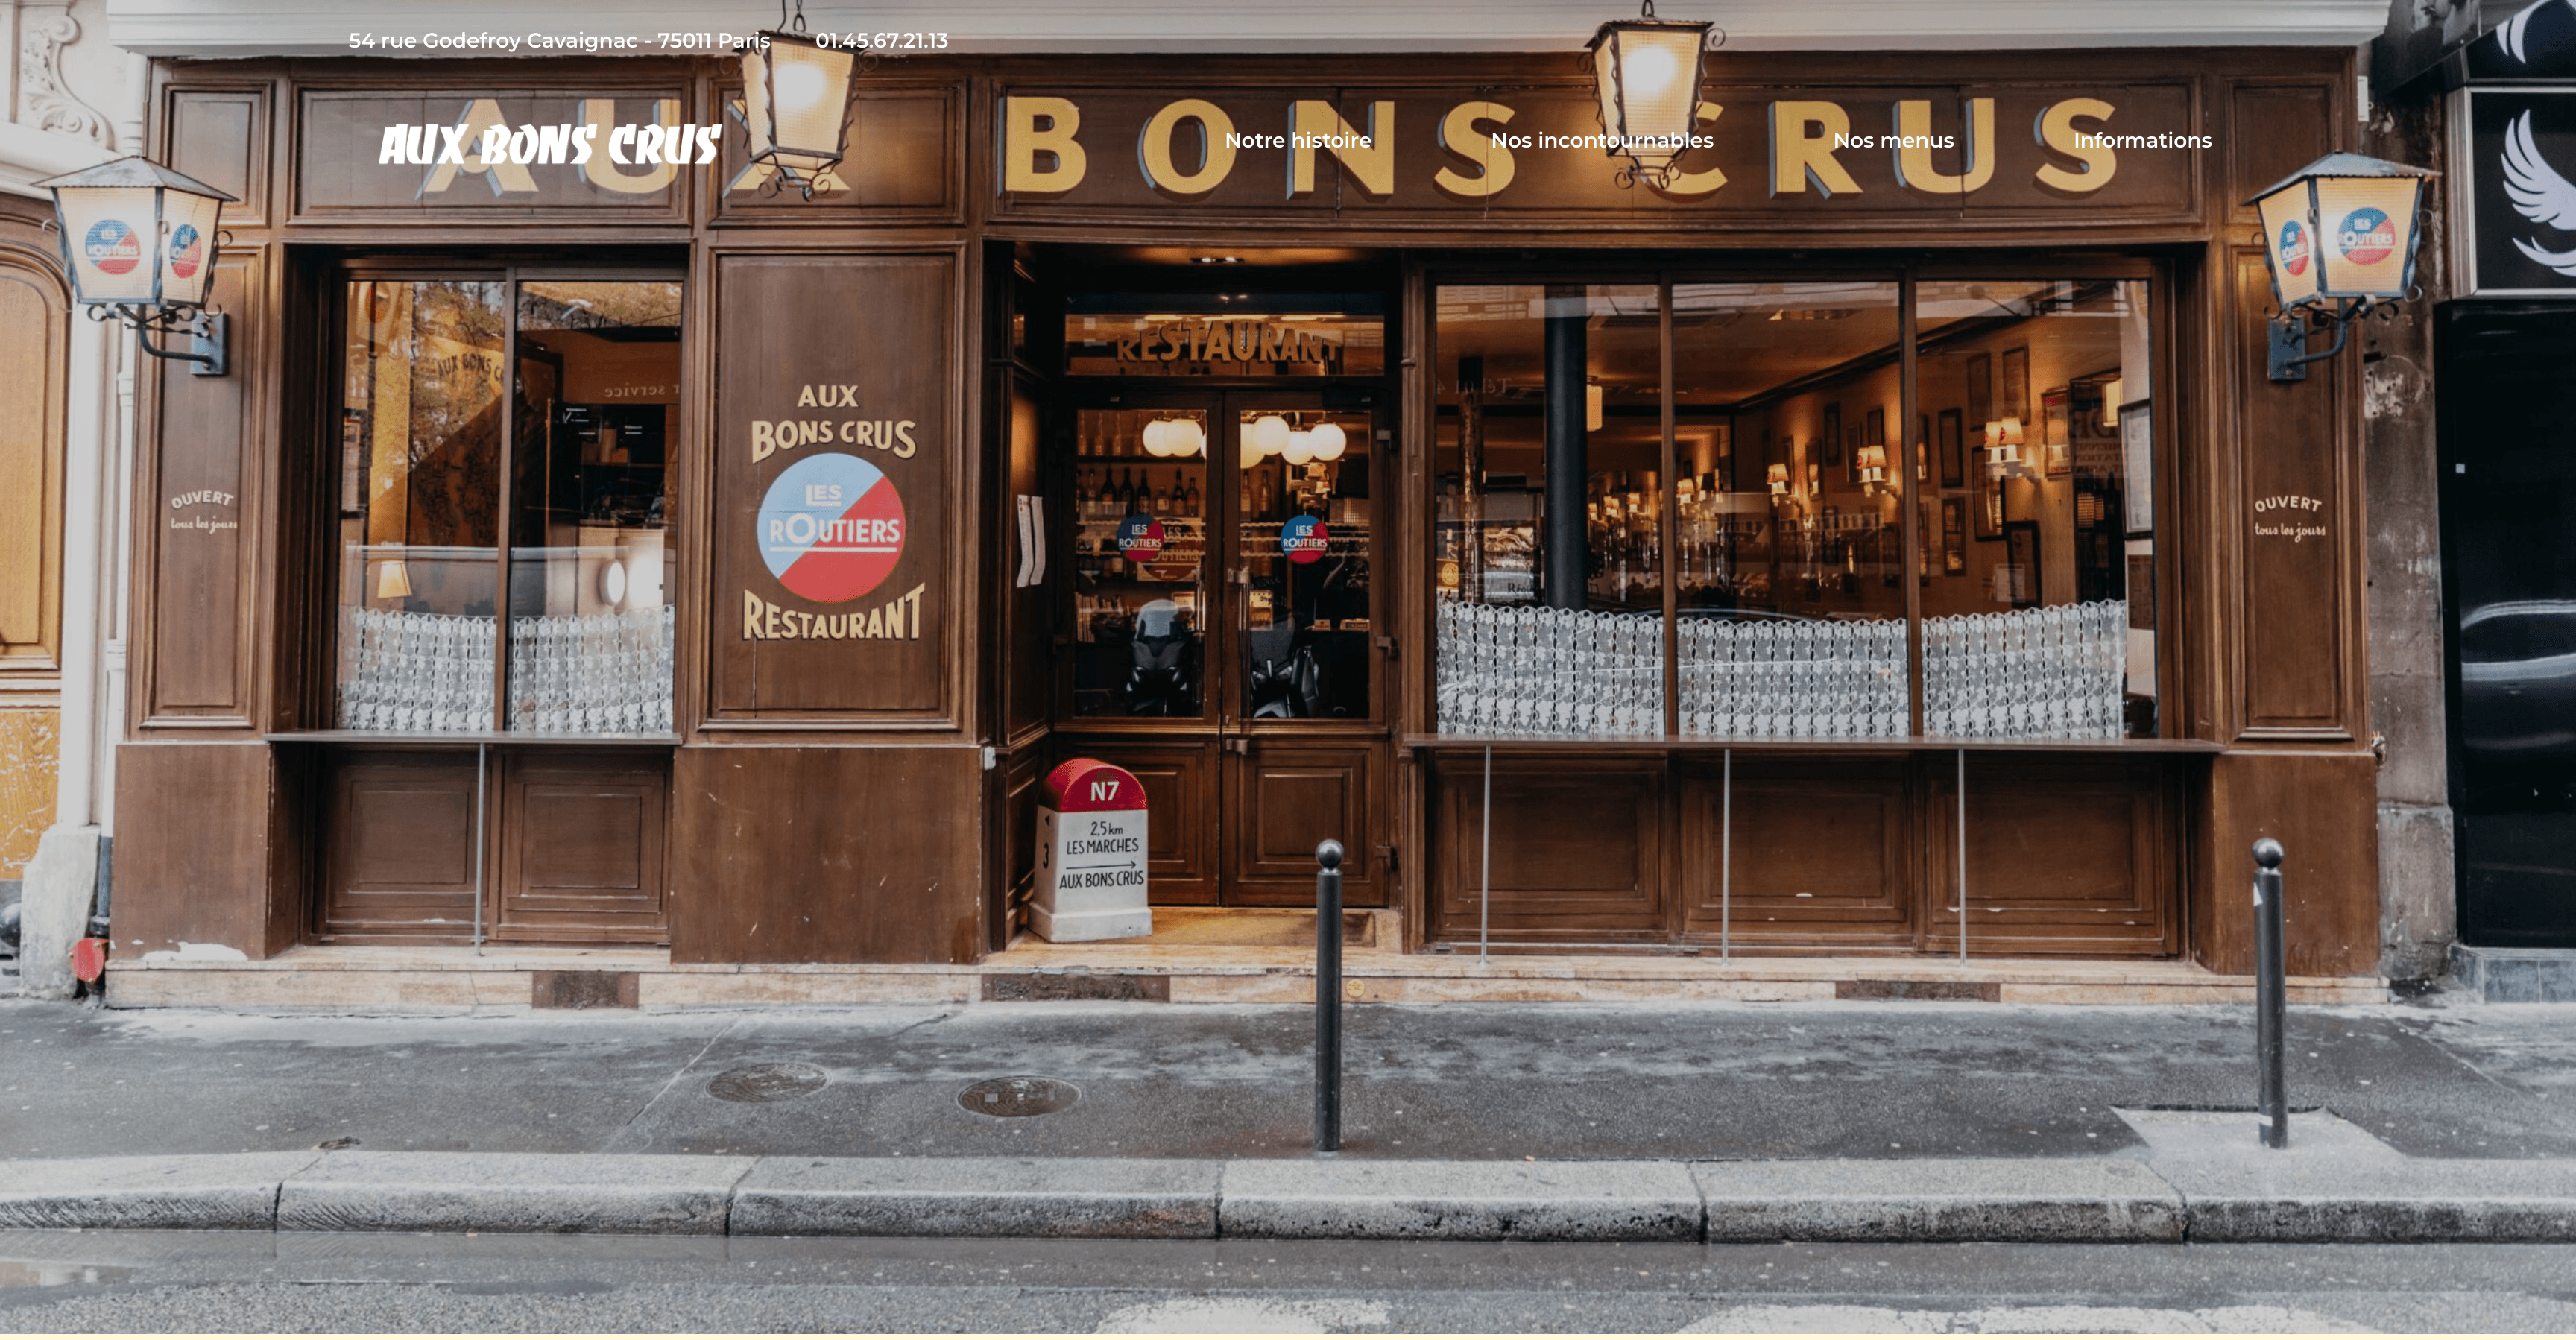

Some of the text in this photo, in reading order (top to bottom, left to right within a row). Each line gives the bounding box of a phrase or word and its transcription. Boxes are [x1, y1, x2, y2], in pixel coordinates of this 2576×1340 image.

[999, 97, 1516, 197] BONS
[1117, 320, 1338, 363] RESTAURANT
[797, 385, 859, 408] AUX
[751, 420, 917, 464] BONS CRUS
[171, 490, 235, 509] OUVERT
[806, 484, 842, 507] LES
[2255, 495, 2323, 513] OUVERT
[170, 517, 194, 529] tous
[195, 515, 209, 529] les
[768, 513, 901, 545] ROUTIERS
[1131, 525, 1148, 535] LES
[1296, 525, 1313, 536] LES
[1118, 537, 1162, 548] ROUTIERS
[1283, 537, 1328, 548] ROUTIERS
[2255, 522, 2326, 543] tous les jours
[743, 582, 925, 641] RESTAURANT
[1090, 780, 1120, 802] N7
[1090, 821, 1123, 837] 2,5 km
[1066, 838, 1140, 855] LES MARCHES
[1058, 870, 1145, 890] AUX BONS CRUS
